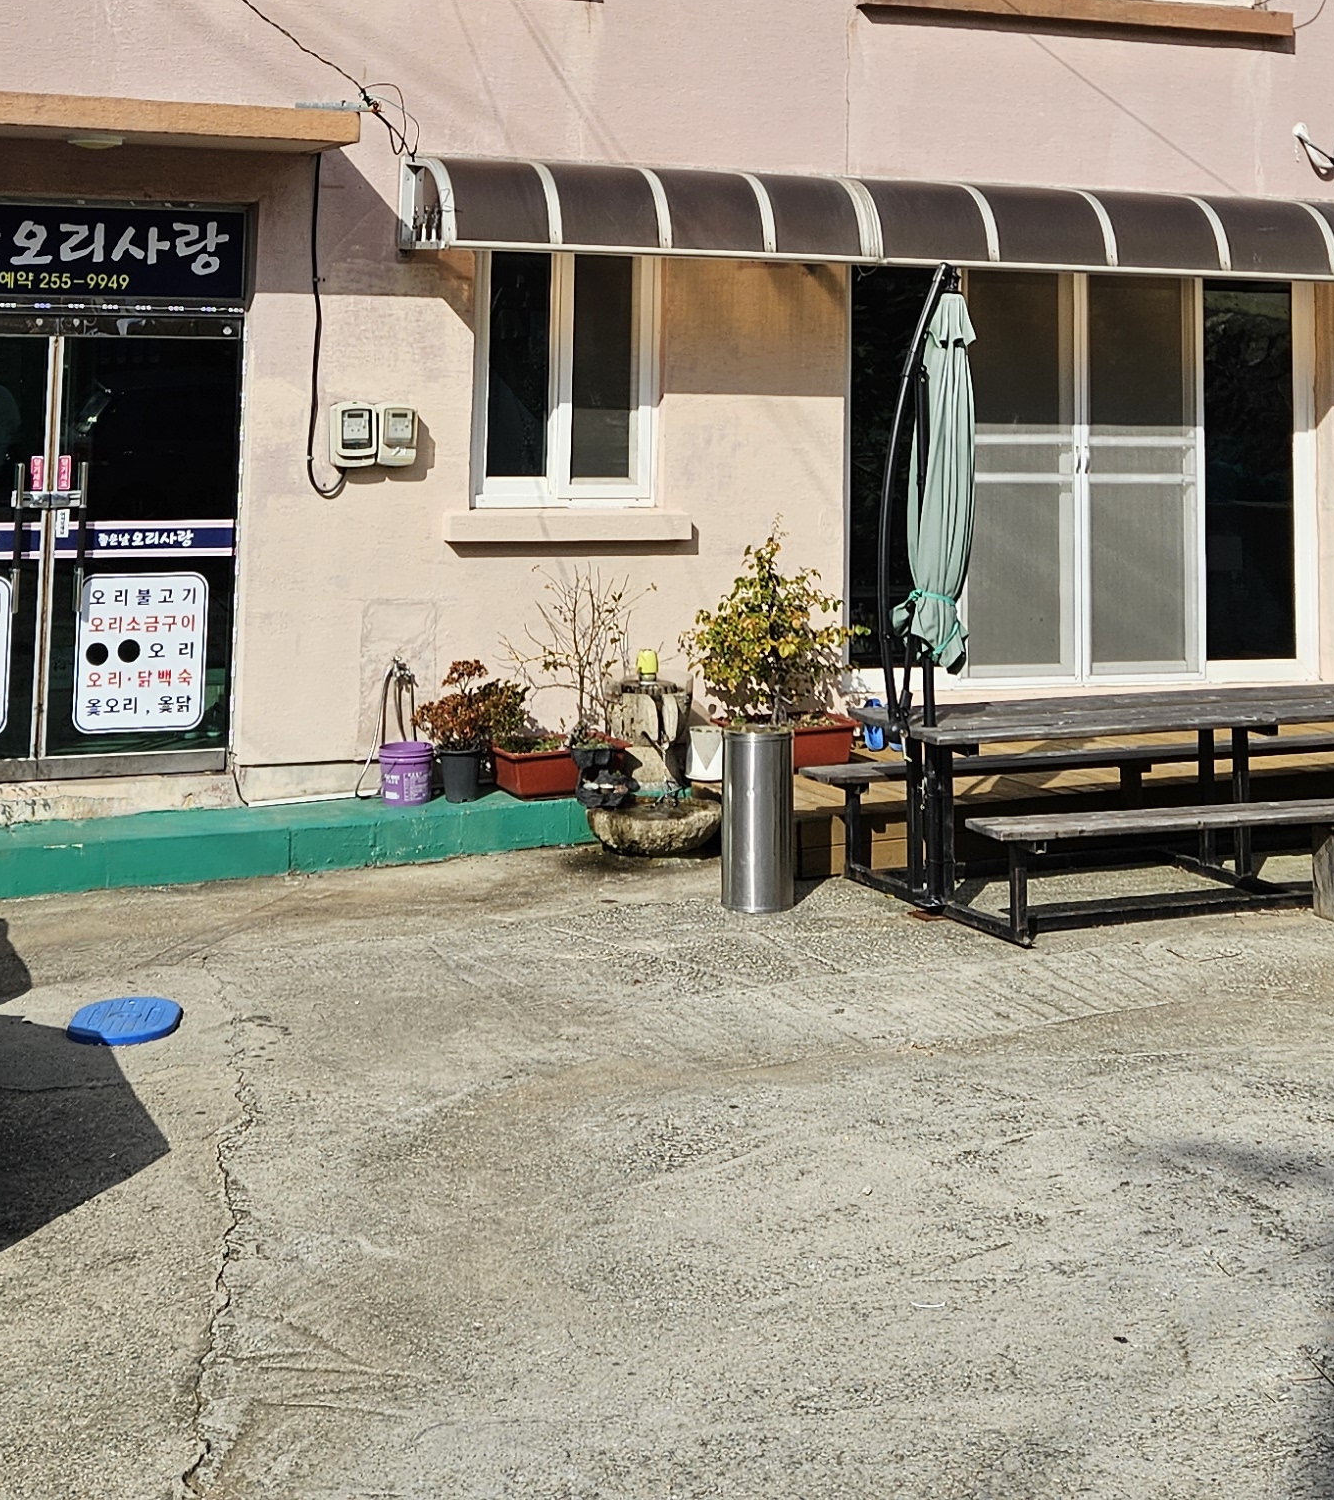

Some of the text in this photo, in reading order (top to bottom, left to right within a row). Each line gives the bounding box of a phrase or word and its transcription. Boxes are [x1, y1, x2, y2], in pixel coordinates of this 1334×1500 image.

[12, 218, 230, 277] 오리사랑
[39, 272, 130, 291] 255-9949
[131, 530, 195, 548] 오리사랑
[89, 587, 197, 607] 오리불고기
[88, 614, 196, 634] 오리소금구이
